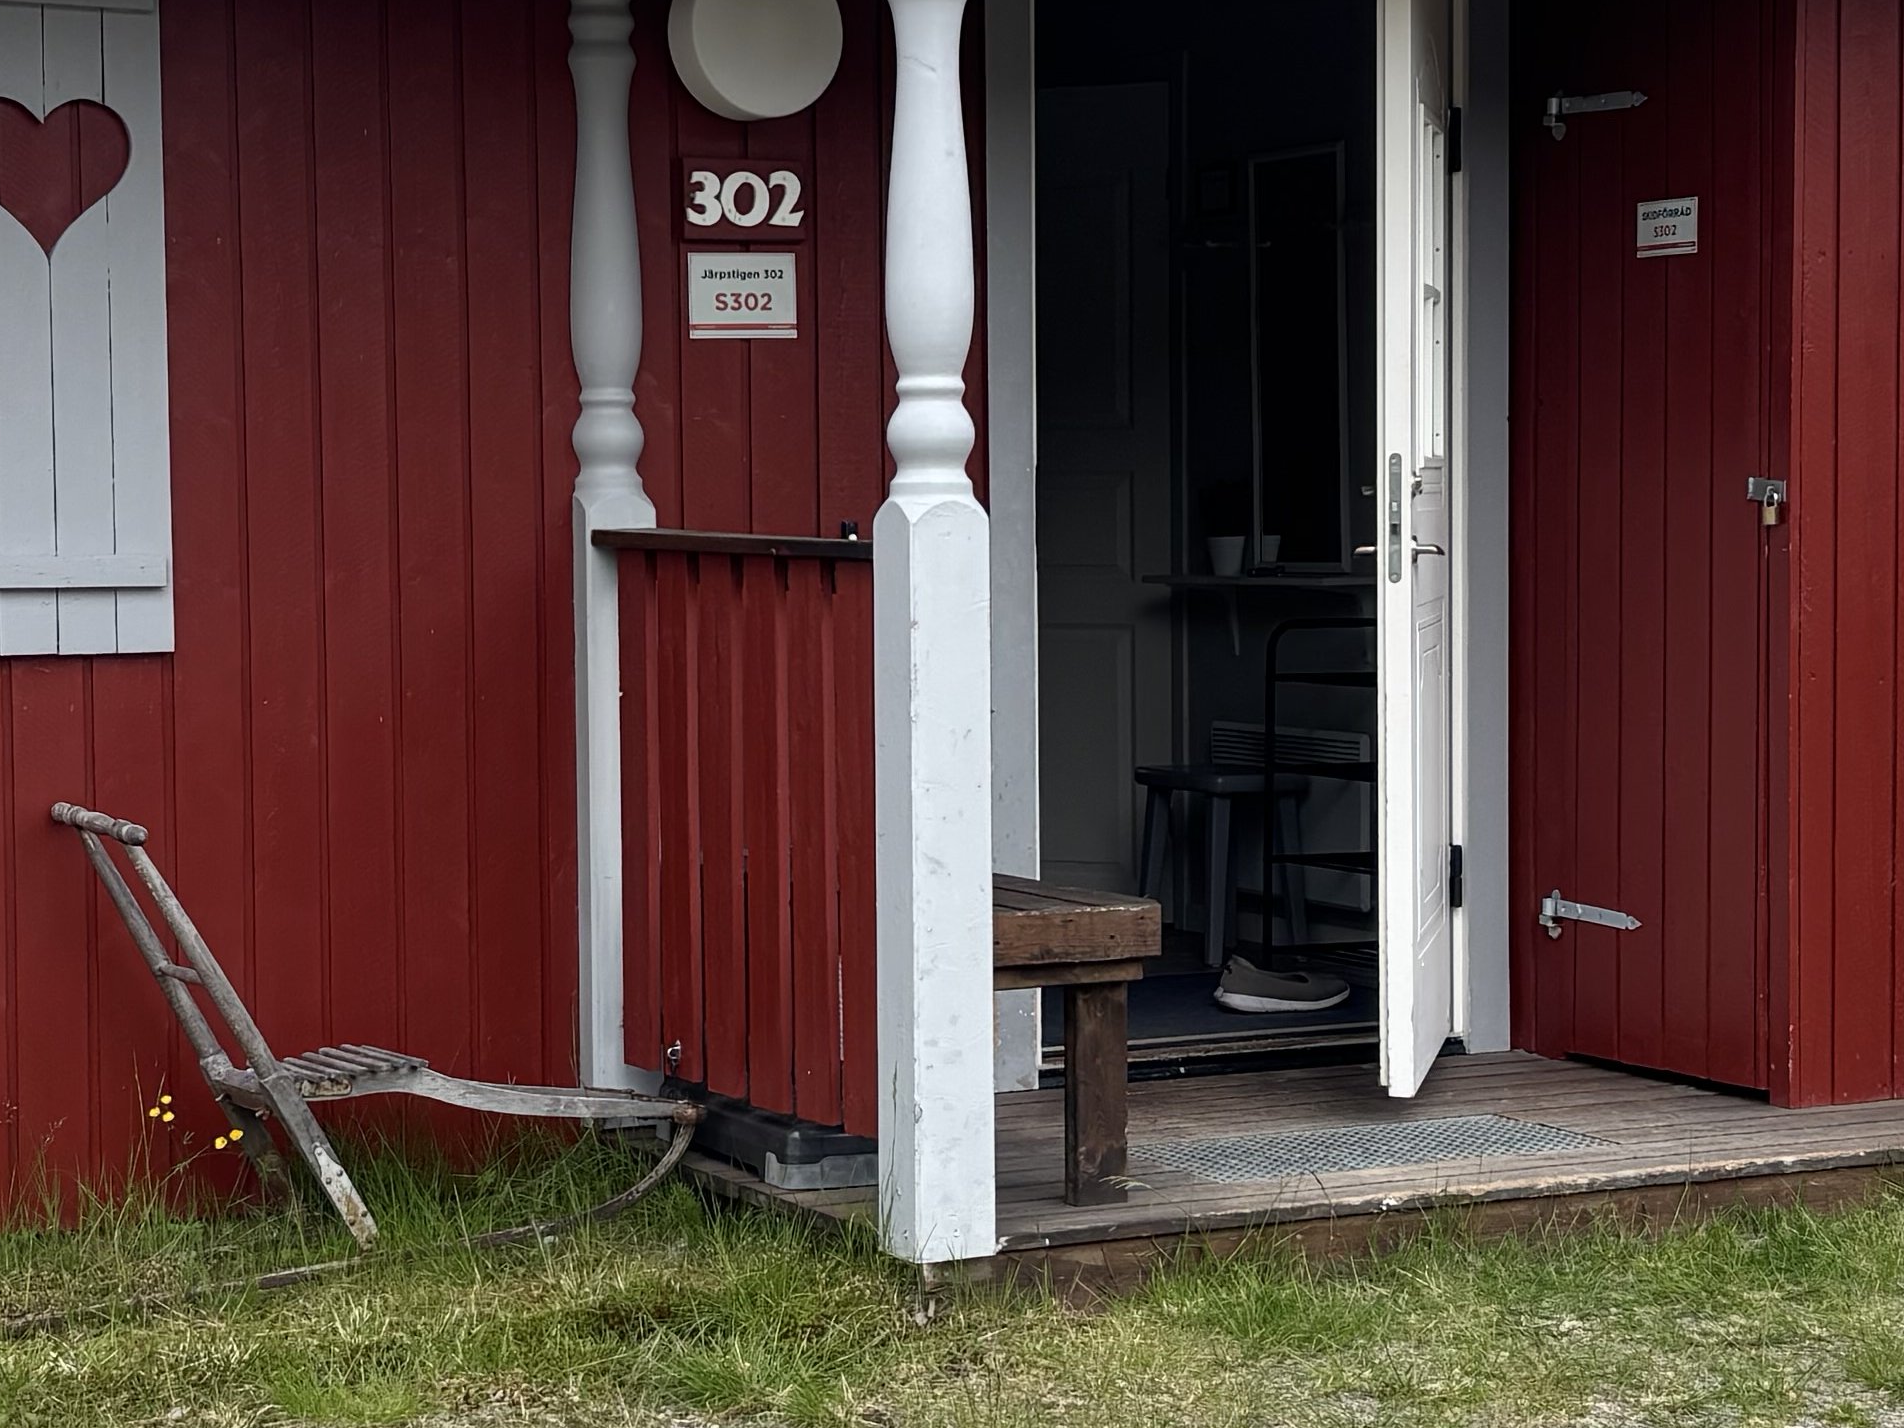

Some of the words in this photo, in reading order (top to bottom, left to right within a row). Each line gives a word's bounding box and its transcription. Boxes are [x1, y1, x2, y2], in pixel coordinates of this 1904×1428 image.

[686, 171, 805, 227] 302
[1653, 224, 1677, 238] S302
[701, 268, 760, 281] Järpstigen
[763, 269, 784, 280] 302
[715, 292, 773, 312] S302
